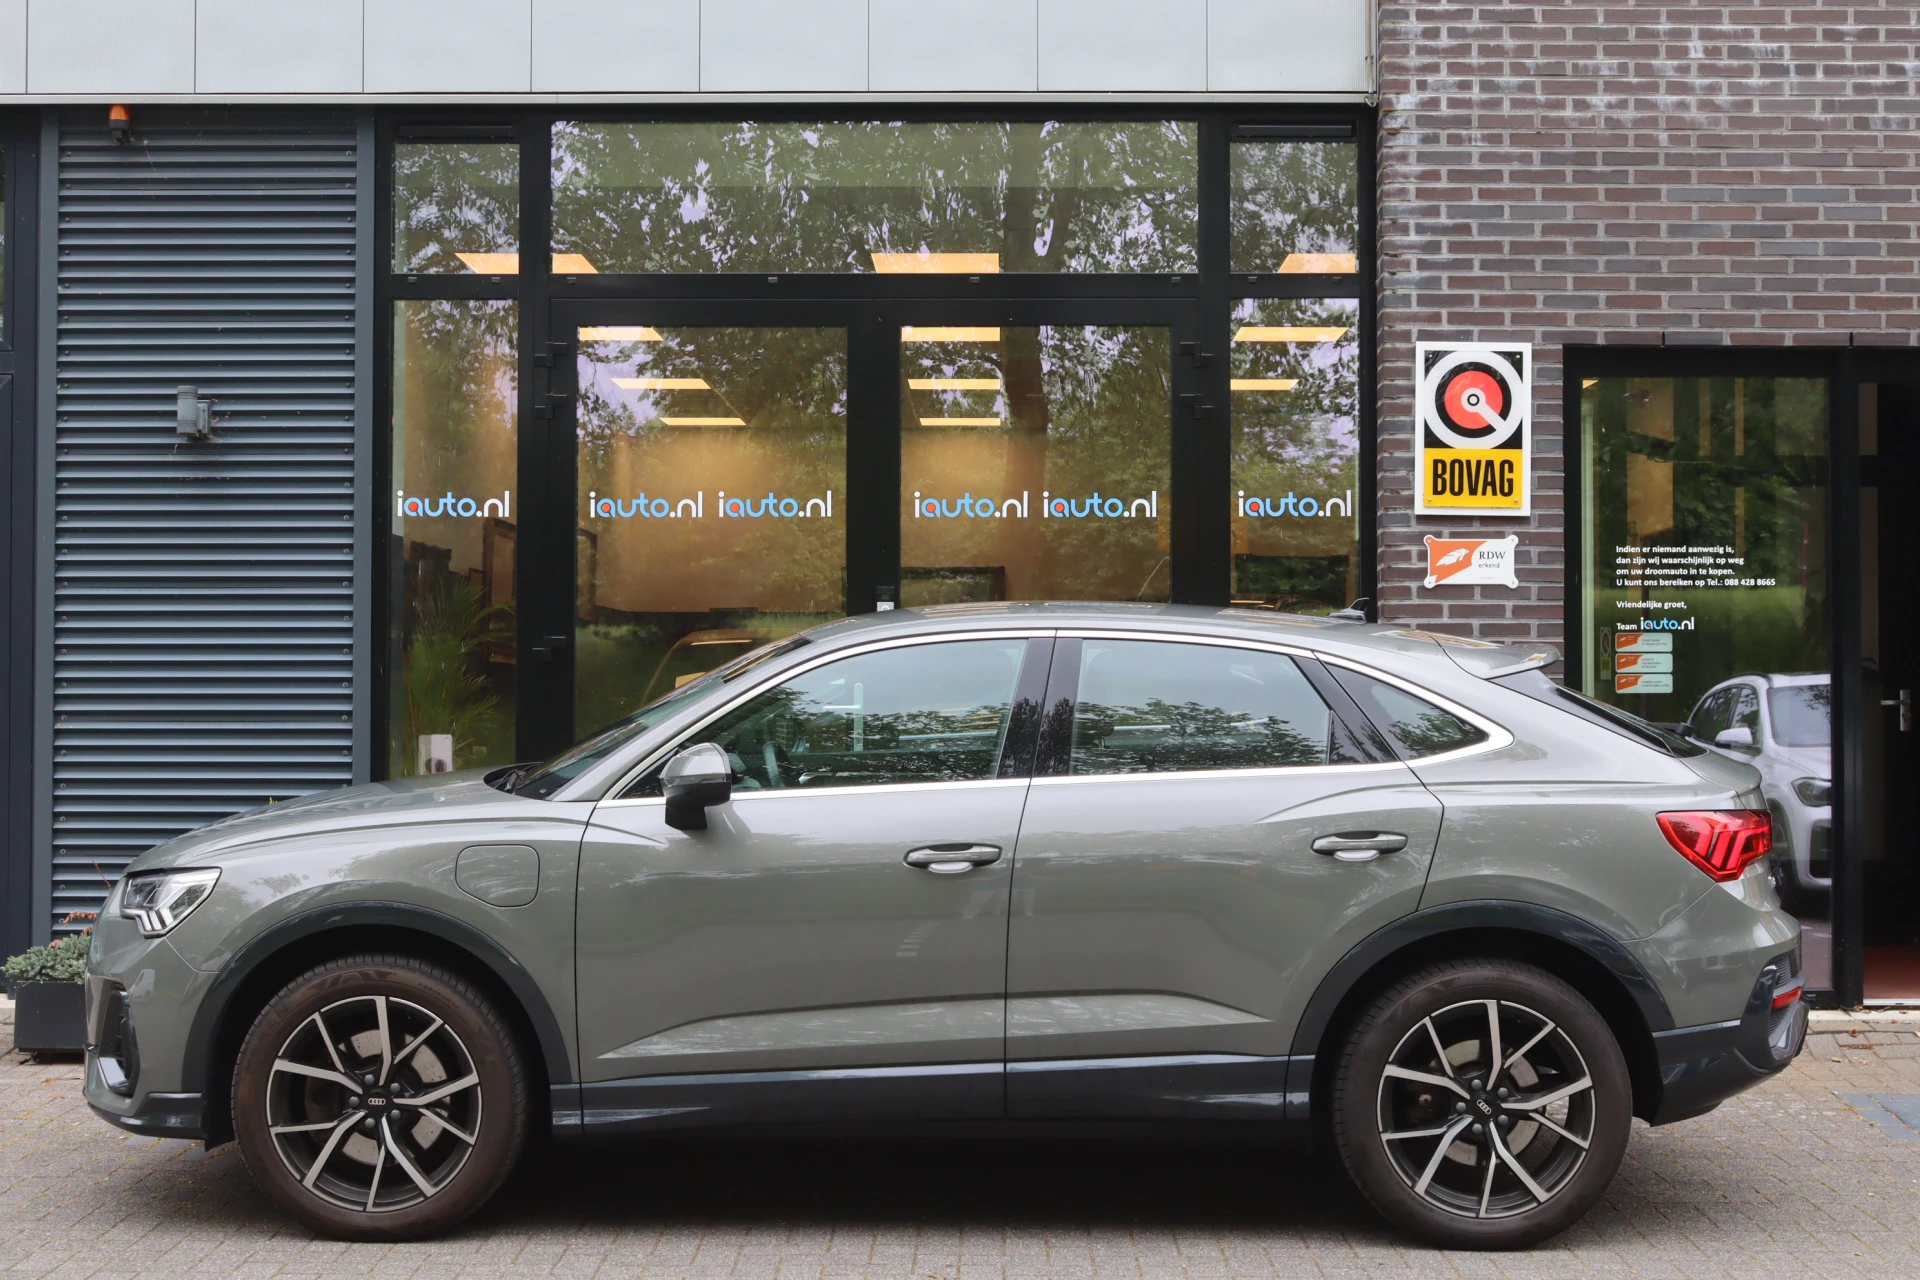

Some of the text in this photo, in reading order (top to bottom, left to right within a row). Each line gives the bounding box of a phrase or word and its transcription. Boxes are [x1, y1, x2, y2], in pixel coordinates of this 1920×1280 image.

[1432, 458, 1514, 497] BOVAG
[397, 490, 510, 518] iauto.nl
[589, 491, 703, 518] iauto.nl
[718, 490, 832, 518] iauto.nl
[914, 491, 1028, 518] iauto.nl
[1043, 491, 1157, 518] iauto.nl
[1238, 490, 1352, 517] iauto.nl
[1478, 551, 1506, 560] RDW
[1616, 545, 1641, 553] Indien
[1652, 545, 1686, 553] niemand
[1688, 545, 1724, 554] aanwezig
[1725, 545, 1734, 554] is,
[1616, 556, 1744, 565] dan zijn wij waarschijnlijk op weg
[1644, 567, 1688, 575] droomauto
[1689, 567, 1697, 575] in
[1708, 567, 1735, 576] kopen.
[1624, 578, 1642, 586] kunt
[1659, 578, 1693, 586] bereiken
[1695, 579, 1705, 587] op
[1706, 578, 1723, 586] Tel.:
[1724, 578, 1739, 586] 088
[1740, 578, 1755, 586] 428
[1756, 578, 1776, 586] 8665
[1616, 601, 1687, 610] Vriendelijke groet,
[1640, 616, 1695, 630] iauto.nl
